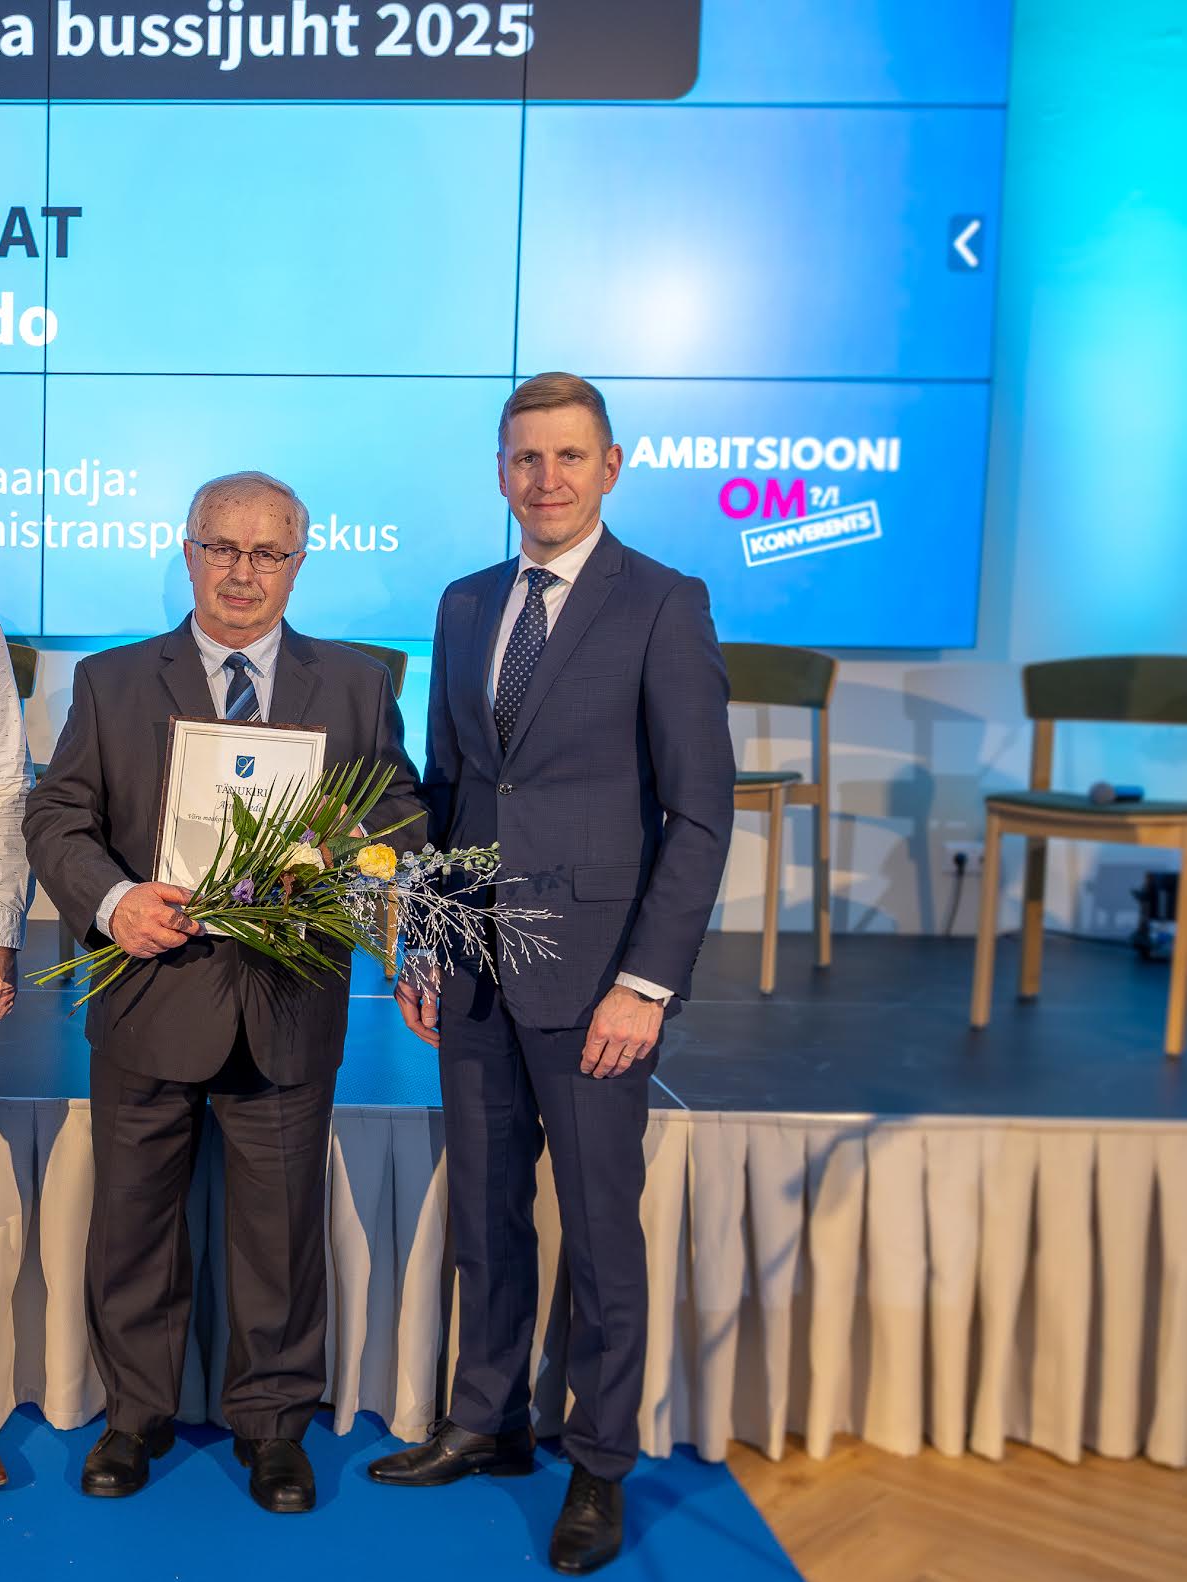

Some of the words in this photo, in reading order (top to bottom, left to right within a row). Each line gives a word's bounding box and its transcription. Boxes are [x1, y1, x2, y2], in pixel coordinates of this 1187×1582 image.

[56, 0, 360, 71] bussijuht
[375, 2, 535, 57] 2025
[629, 436, 901, 471] AMBITSIOONI
[718, 477, 808, 519] OM
[749, 509, 872, 555] KONVERENTS
